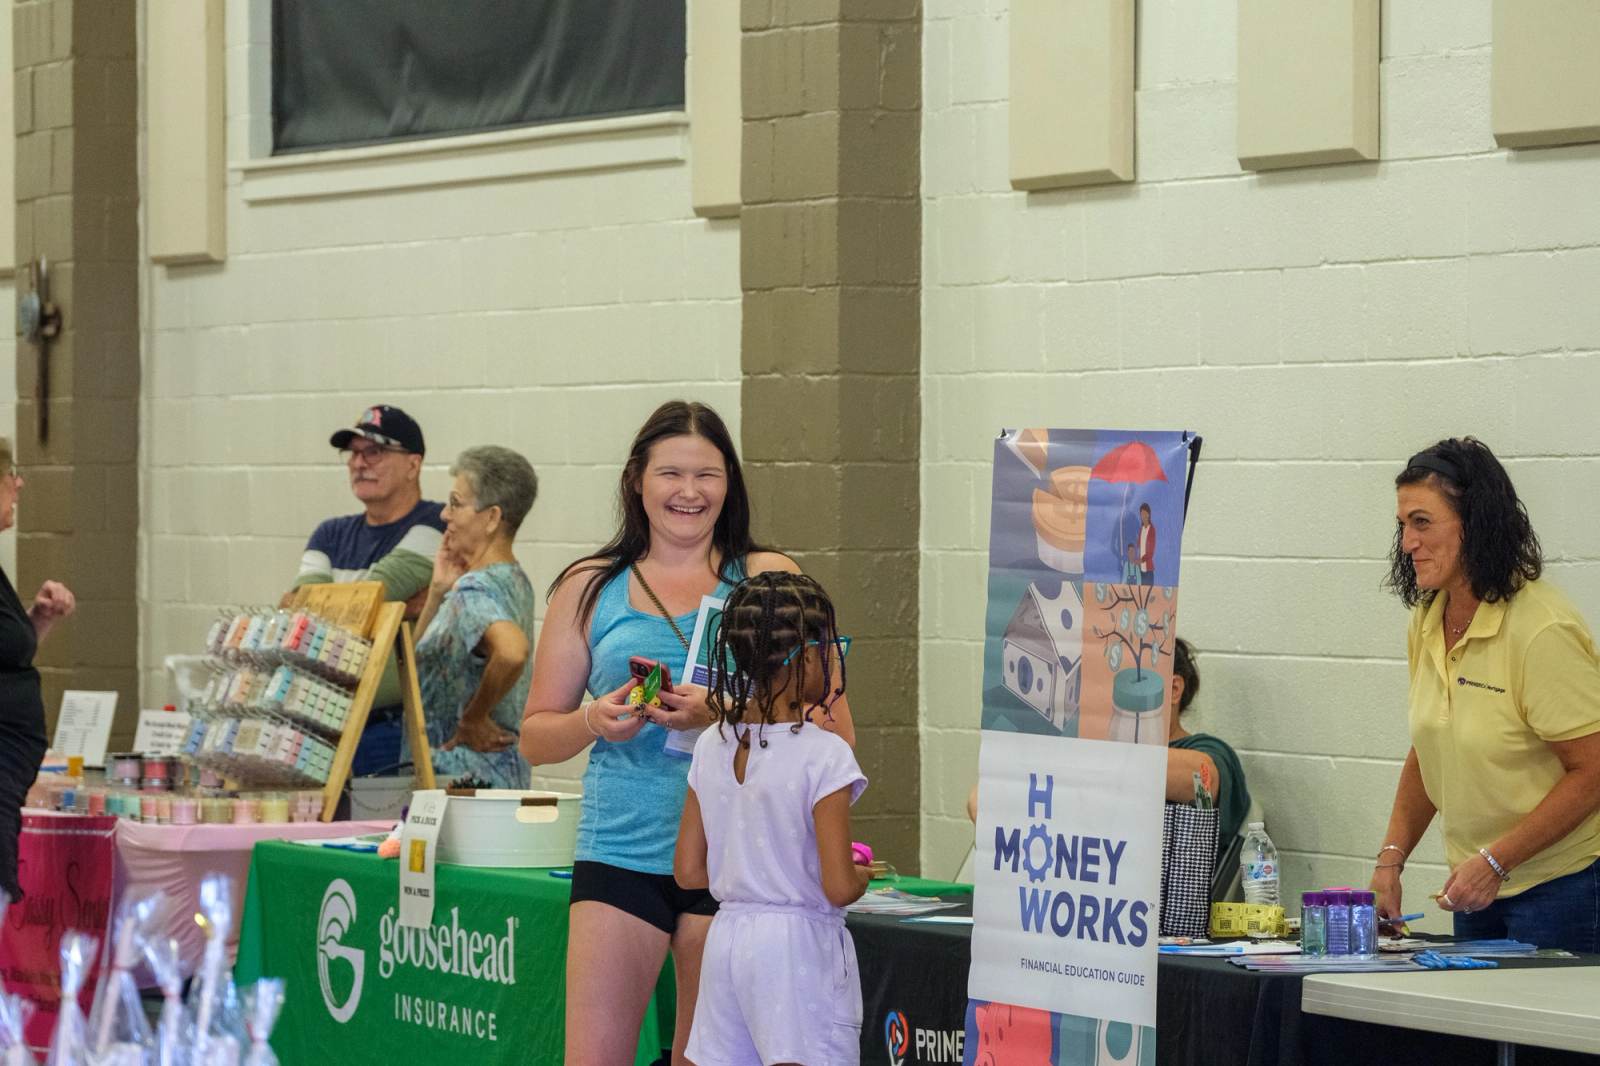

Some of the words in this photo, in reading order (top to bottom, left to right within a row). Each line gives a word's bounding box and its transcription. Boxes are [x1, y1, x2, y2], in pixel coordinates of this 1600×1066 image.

[993, 823, 1127, 886] MONEY
[379, 907, 516, 985] goosehead
[1019, 887, 1149, 948] WORKS
[1020, 958, 1062, 975] FINANCIAL
[1064, 965, 1115, 982] EDUCATION
[1118, 972, 1145, 986] GUIDE
[395, 993, 497, 1041] INSURANCE
